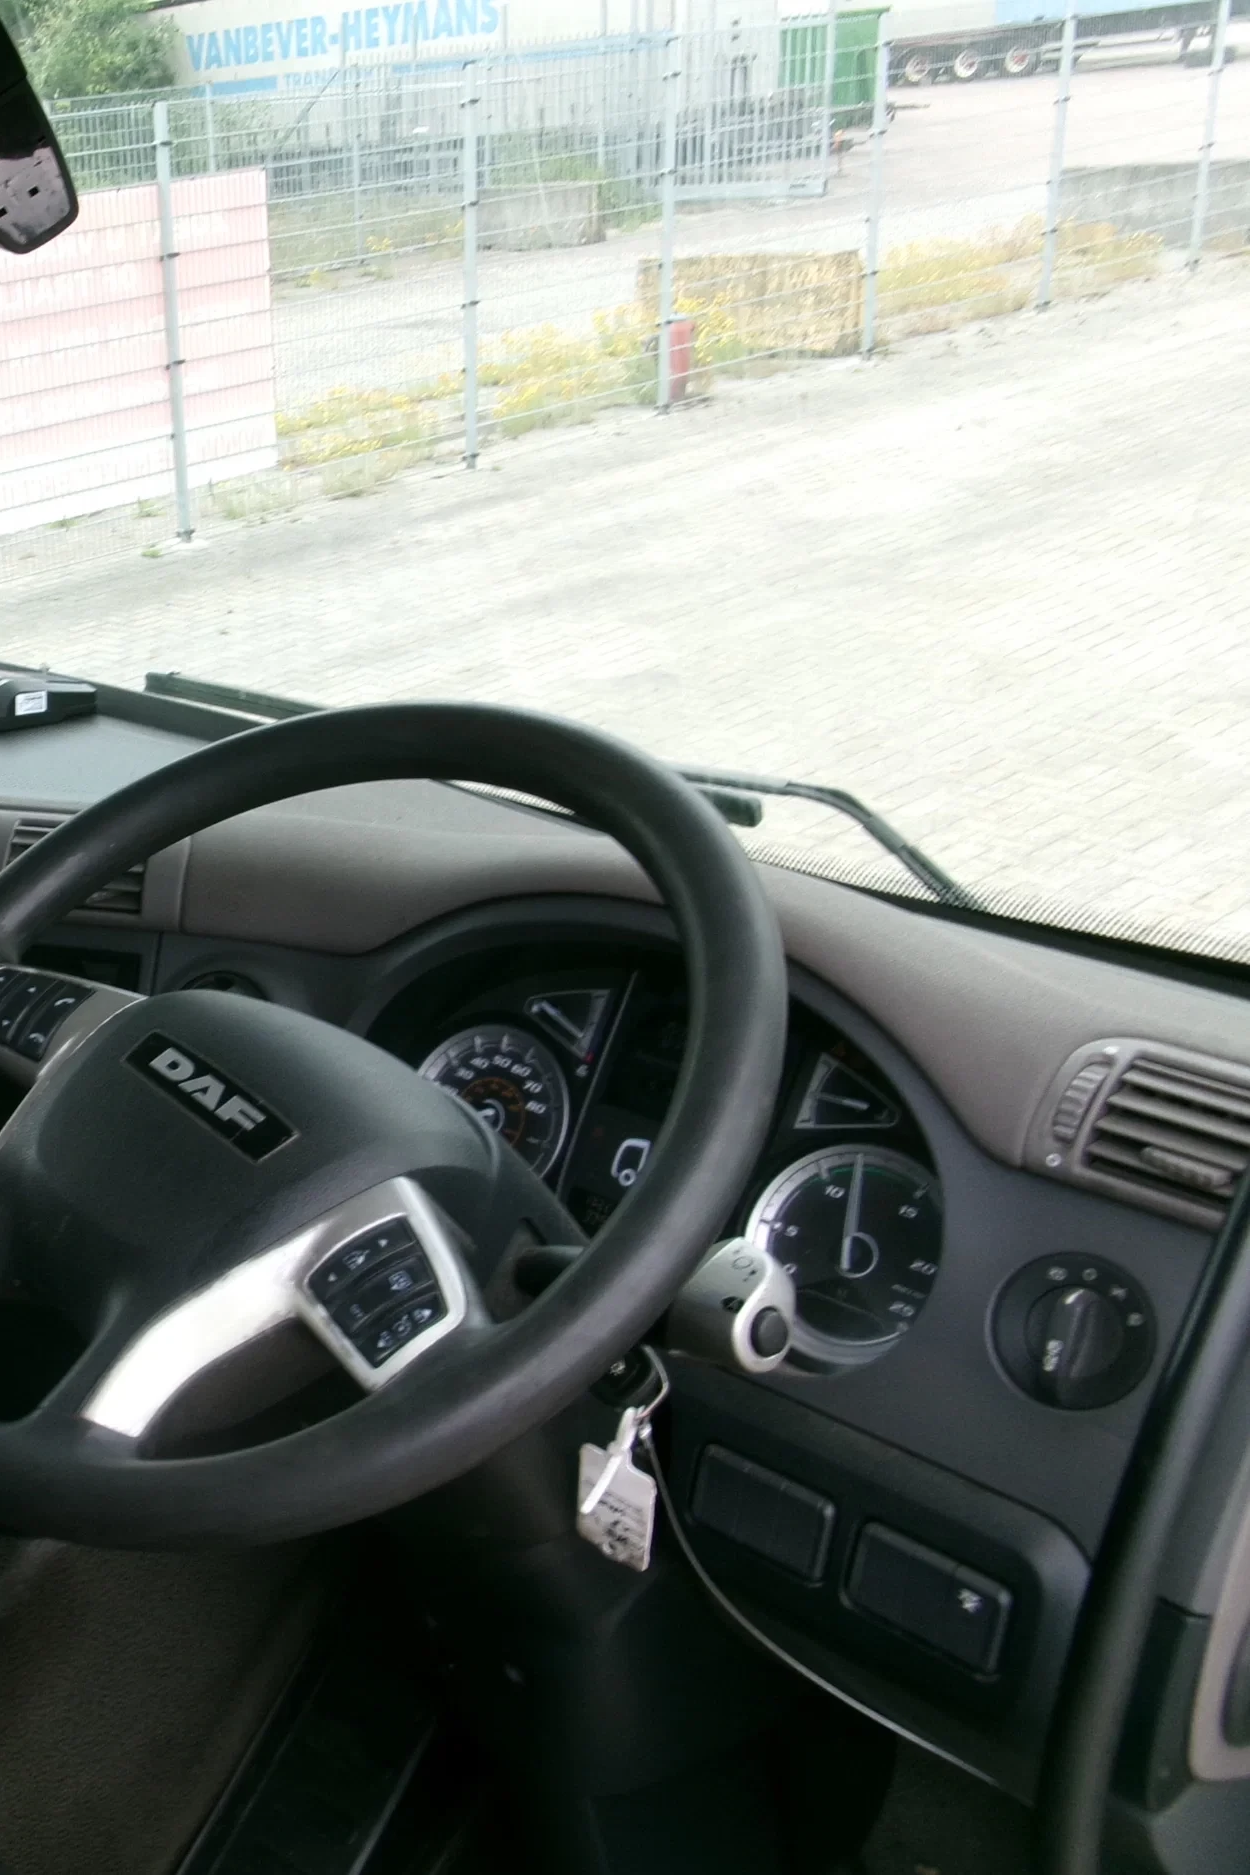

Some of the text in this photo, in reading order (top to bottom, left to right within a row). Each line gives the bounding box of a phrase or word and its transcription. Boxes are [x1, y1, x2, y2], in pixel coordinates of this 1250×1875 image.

[186, 0, 501, 73] VANBEVER-HEYMANS
[510, 1063, 532, 1077] 60
[149, 1047, 267, 1131] DAF
[523, 1079, 543, 1093] 70
[824, 1184, 845, 1198] 10
[898, 1205, 919, 1218] 15
